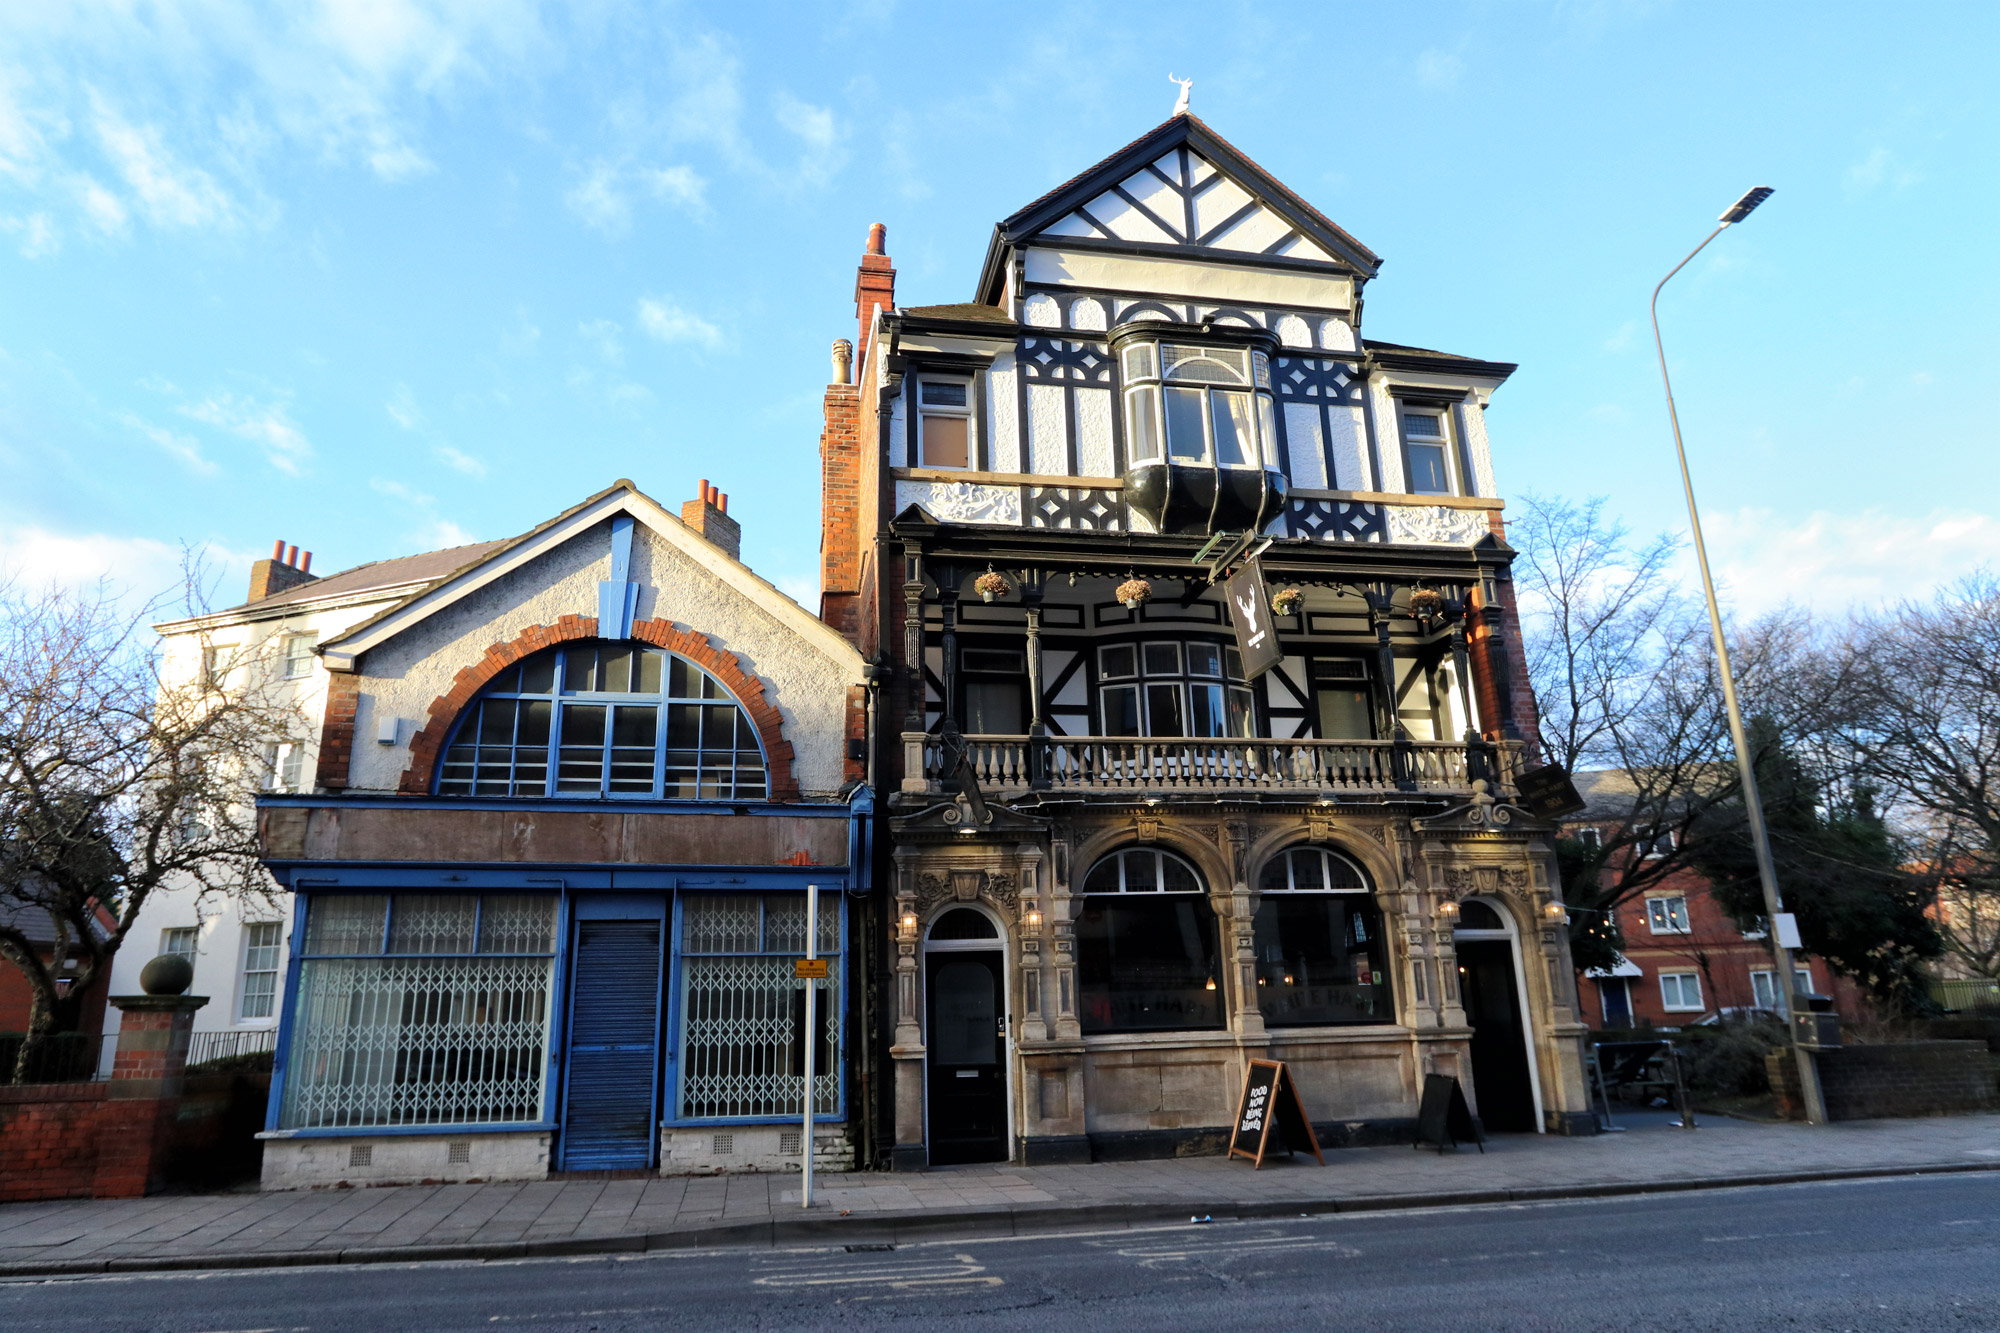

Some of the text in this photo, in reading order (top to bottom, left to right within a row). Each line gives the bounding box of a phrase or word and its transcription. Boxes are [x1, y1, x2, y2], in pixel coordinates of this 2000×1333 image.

[1250, 1086, 1268, 1098] FOOD
[1249, 1096, 1266, 1108] NOW
[1246, 1108, 1262, 1120] BEING
[1242, 1118, 1262, 1132] SERVED
